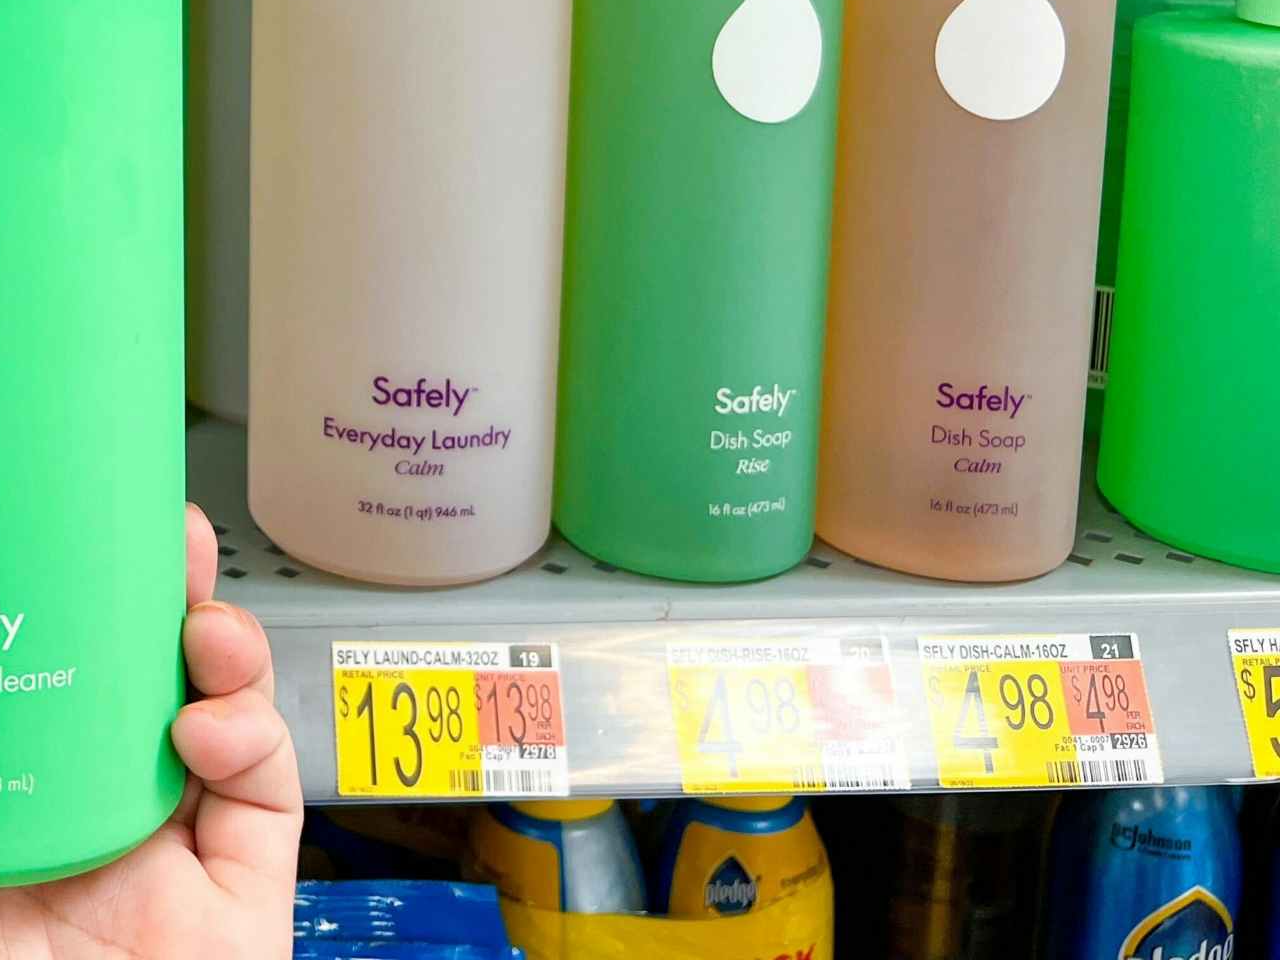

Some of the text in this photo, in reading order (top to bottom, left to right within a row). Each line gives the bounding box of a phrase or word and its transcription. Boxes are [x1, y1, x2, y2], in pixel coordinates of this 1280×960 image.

[323, 416, 512, 456] Everyday Laundry
[710, 428, 792, 450] Dish Soap
[931, 424, 1026, 453] Dish Soap
[394, 459, 445, 476] Calm
[735, 457, 771, 475] Rise
[953, 457, 1003, 474] Calm
[357, 500, 373, 513] 32
[375, 501, 385, 514] fl
[386, 506, 401, 517] oz
[434, 504, 458, 518] 946
[708, 502, 721, 516] 16
[722, 502, 731, 516] fl
[732, 505, 747, 516] oz
[747, 499, 770, 518] (473
[930, 498, 942, 512] 16
[945, 498, 954, 514] fl
[956, 505, 970, 515] oz
[973, 501, 999, 518] (473
[923, 643, 1069, 660] SFLY DISH-CALM-16OZ
[1101, 642, 1121, 659] 21
[1234, 639, 1266, 654] SFLY
[336, 650, 499, 667] SFLY LAUND-CALM-32OZ
[519, 651, 541, 668] 19
[1114, 733, 1147, 749] 2926
[521, 743, 557, 759] 2978
